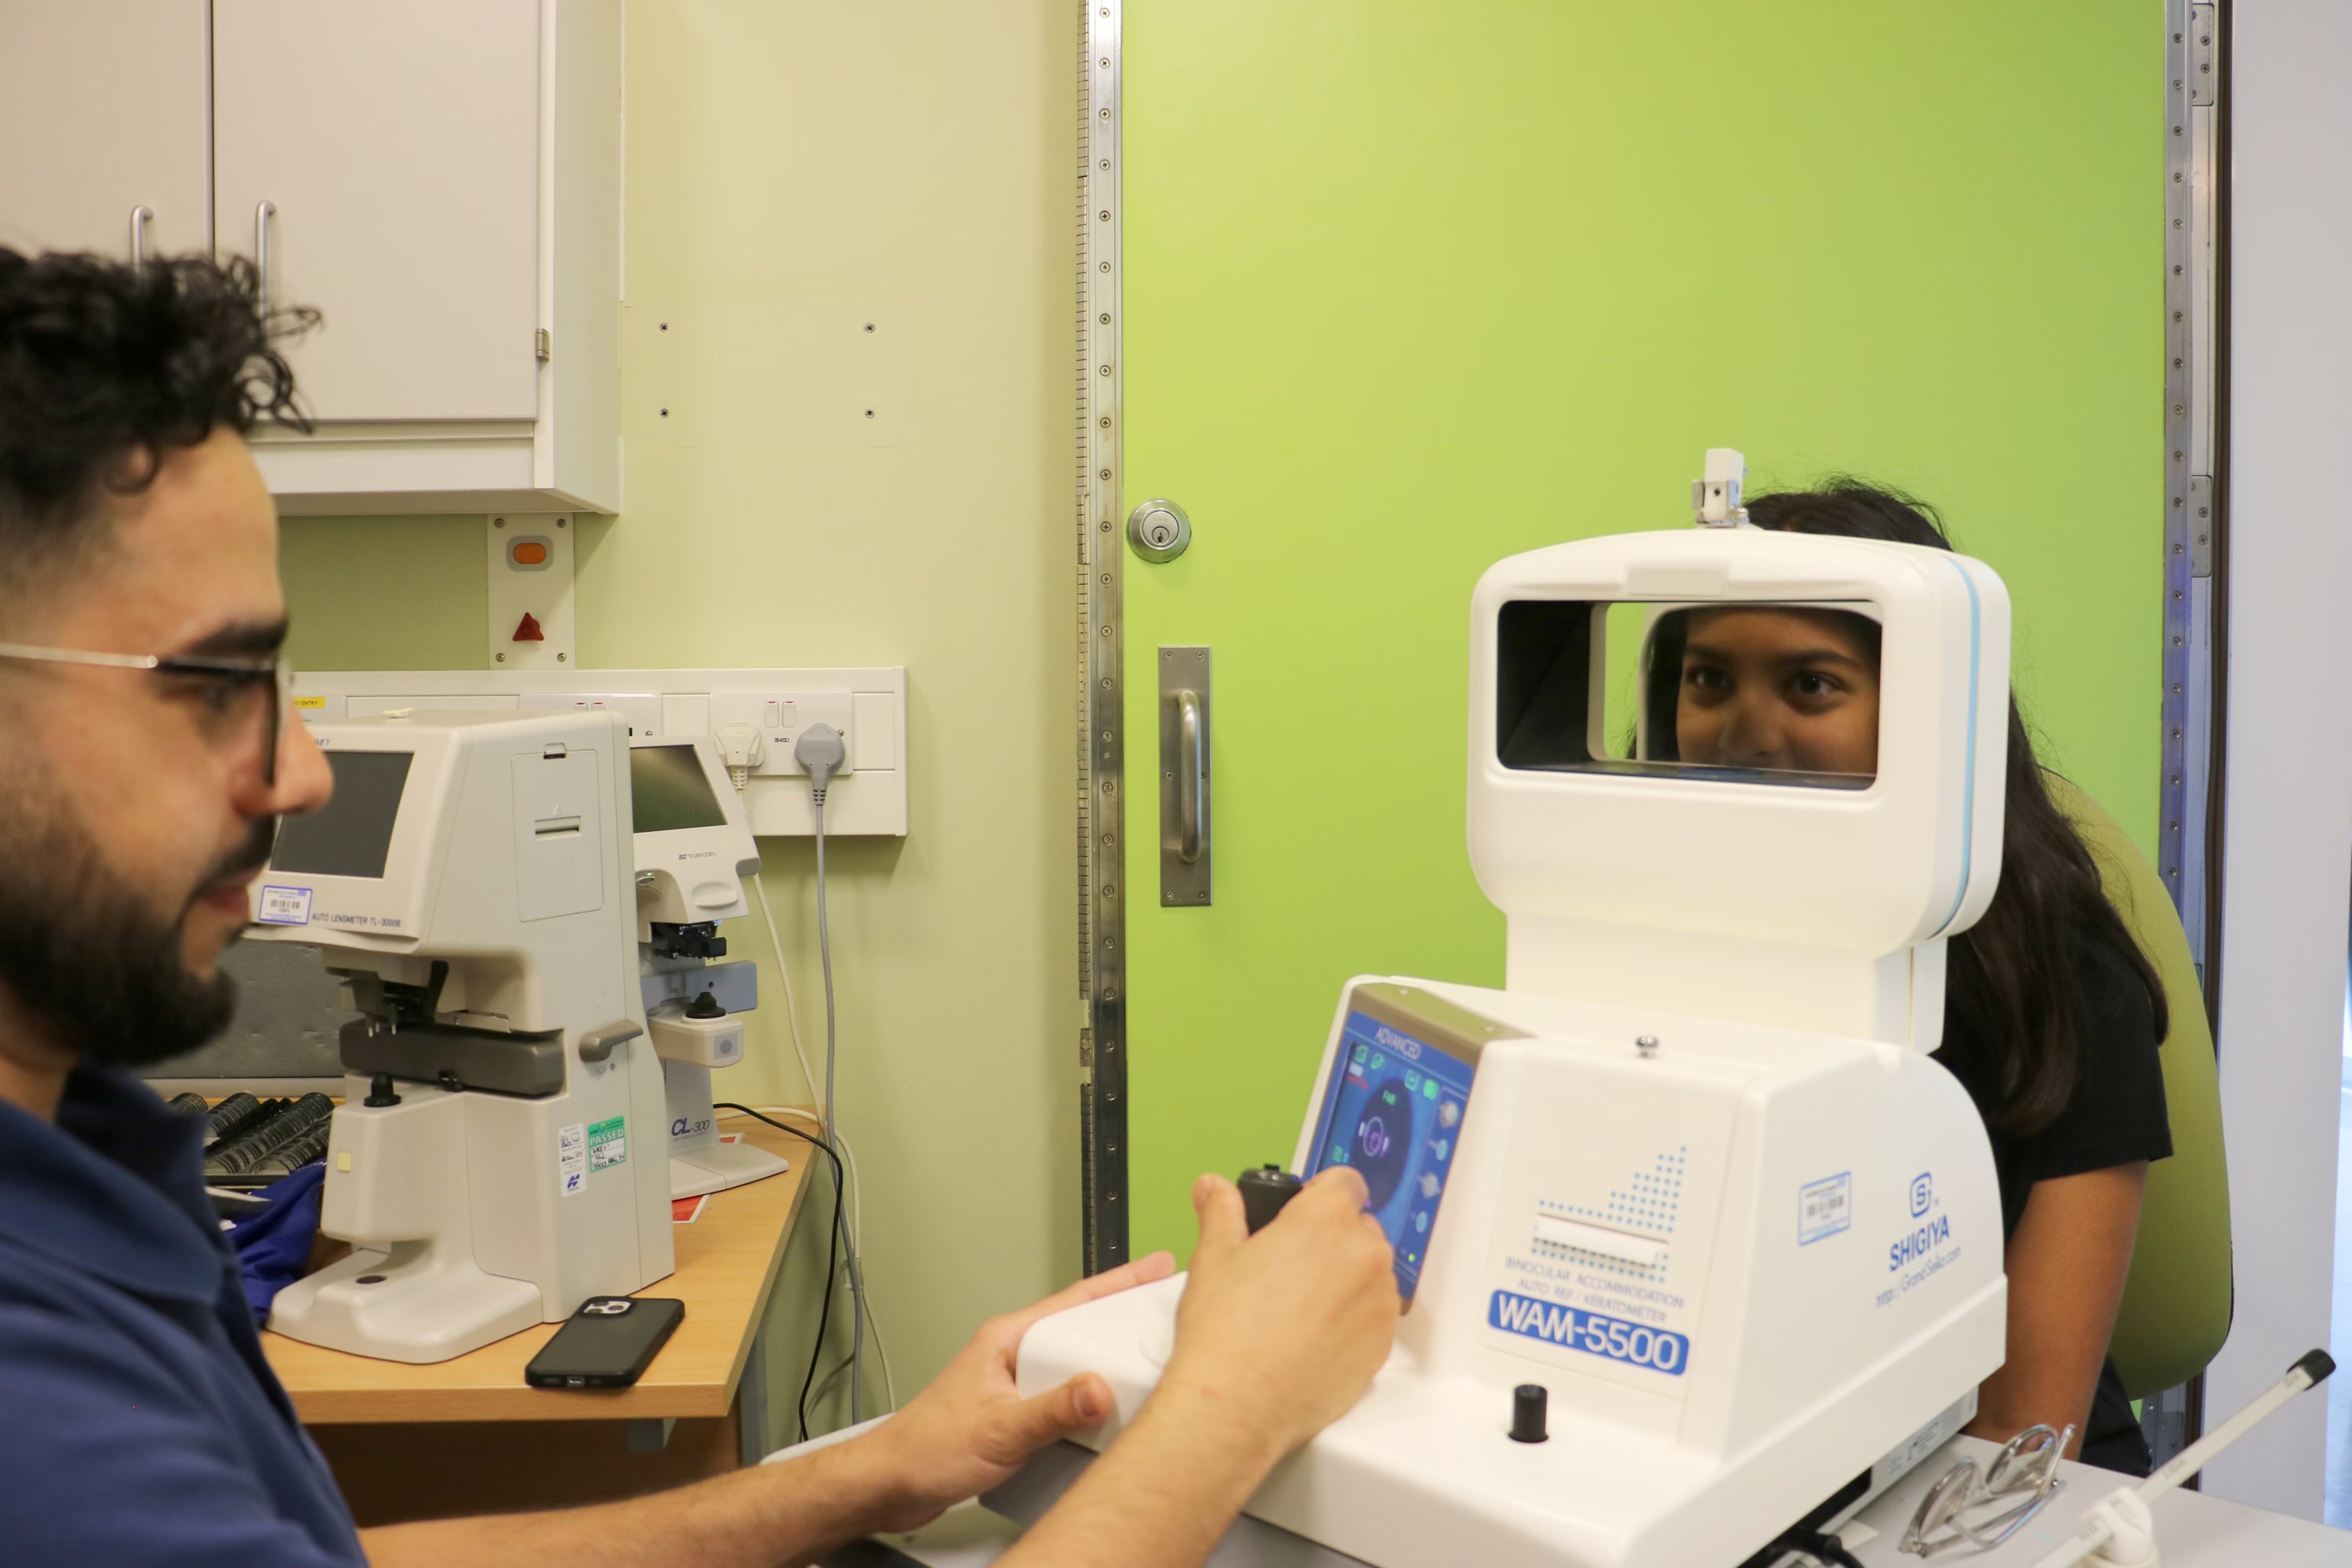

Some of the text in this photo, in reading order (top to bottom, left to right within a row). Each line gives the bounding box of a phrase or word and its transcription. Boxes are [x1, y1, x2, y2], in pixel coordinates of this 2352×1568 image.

[312, 913, 329, 923] AUTO
[331, 914, 368, 925] LENSMETER
[370, 917, 401, 927] TL-3000B
[1374, 1026, 1421, 1060] ADVANCED
[590, 1129, 624, 1145] PASSED
[671, 1117, 710, 1137] CL-300
[1889, 1214, 1950, 1272] SHIGIYA
[1505, 1256, 1684, 1309] BINOCULAR ACCOMMODATION
[1518, 1278, 1548, 1294] AUTO
[1553, 1287, 1573, 1301] REF
[1582, 1293, 1668, 1323] KERATOMETER
[1498, 1294, 1681, 1370] WAM-5500
